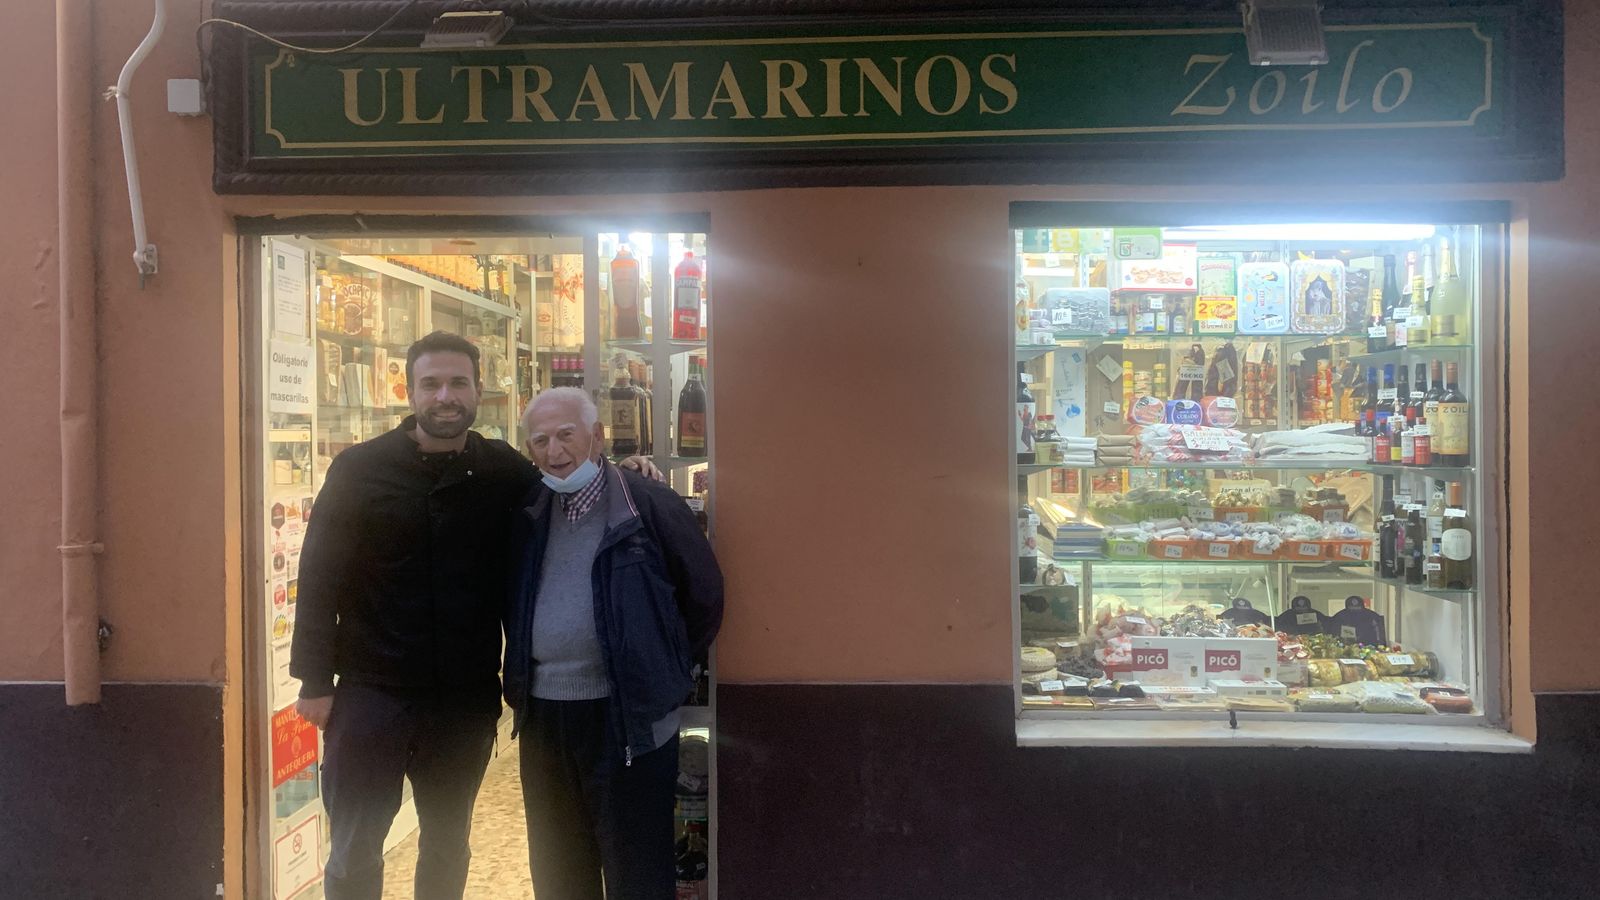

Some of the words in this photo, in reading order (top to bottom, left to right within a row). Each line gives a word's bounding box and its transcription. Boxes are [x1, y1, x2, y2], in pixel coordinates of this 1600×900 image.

[1170, 39, 1413, 115] Zoilo
[340, 53, 1018, 126] ULTRAMARINOS
[279, 374, 293, 383] uso
[294, 374, 302, 385] de
[270, 392, 310, 404] mascarillas
[1137, 653, 1165, 665] PICÓ
[1209, 655, 1237, 666] PICÓ
[277, 749, 315, 779] ANTEQUERA
